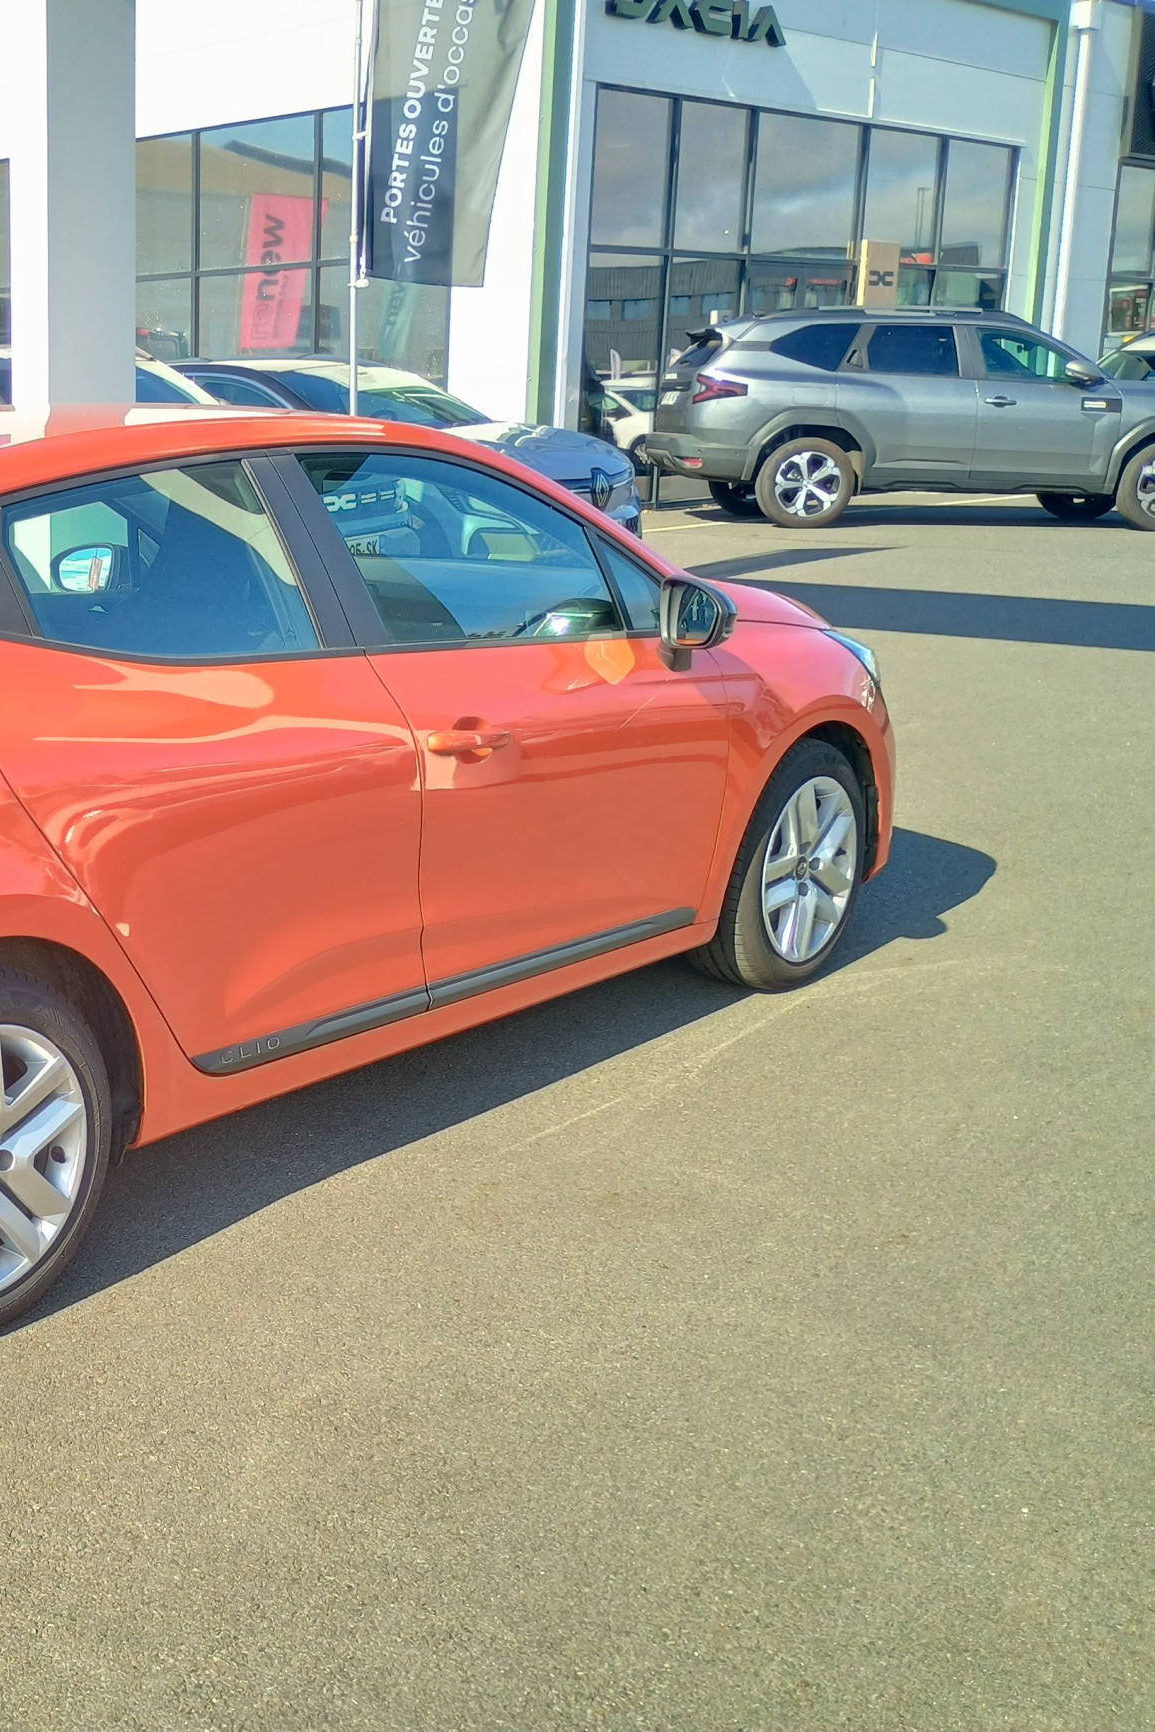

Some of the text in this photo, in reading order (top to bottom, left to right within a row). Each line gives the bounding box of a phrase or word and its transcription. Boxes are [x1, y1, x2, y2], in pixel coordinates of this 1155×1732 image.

[380, 122, 417, 224] PORTES
[403, 0, 475, 263] véhicules d'occa
[220, 1035, 280, 1064] CLIO
